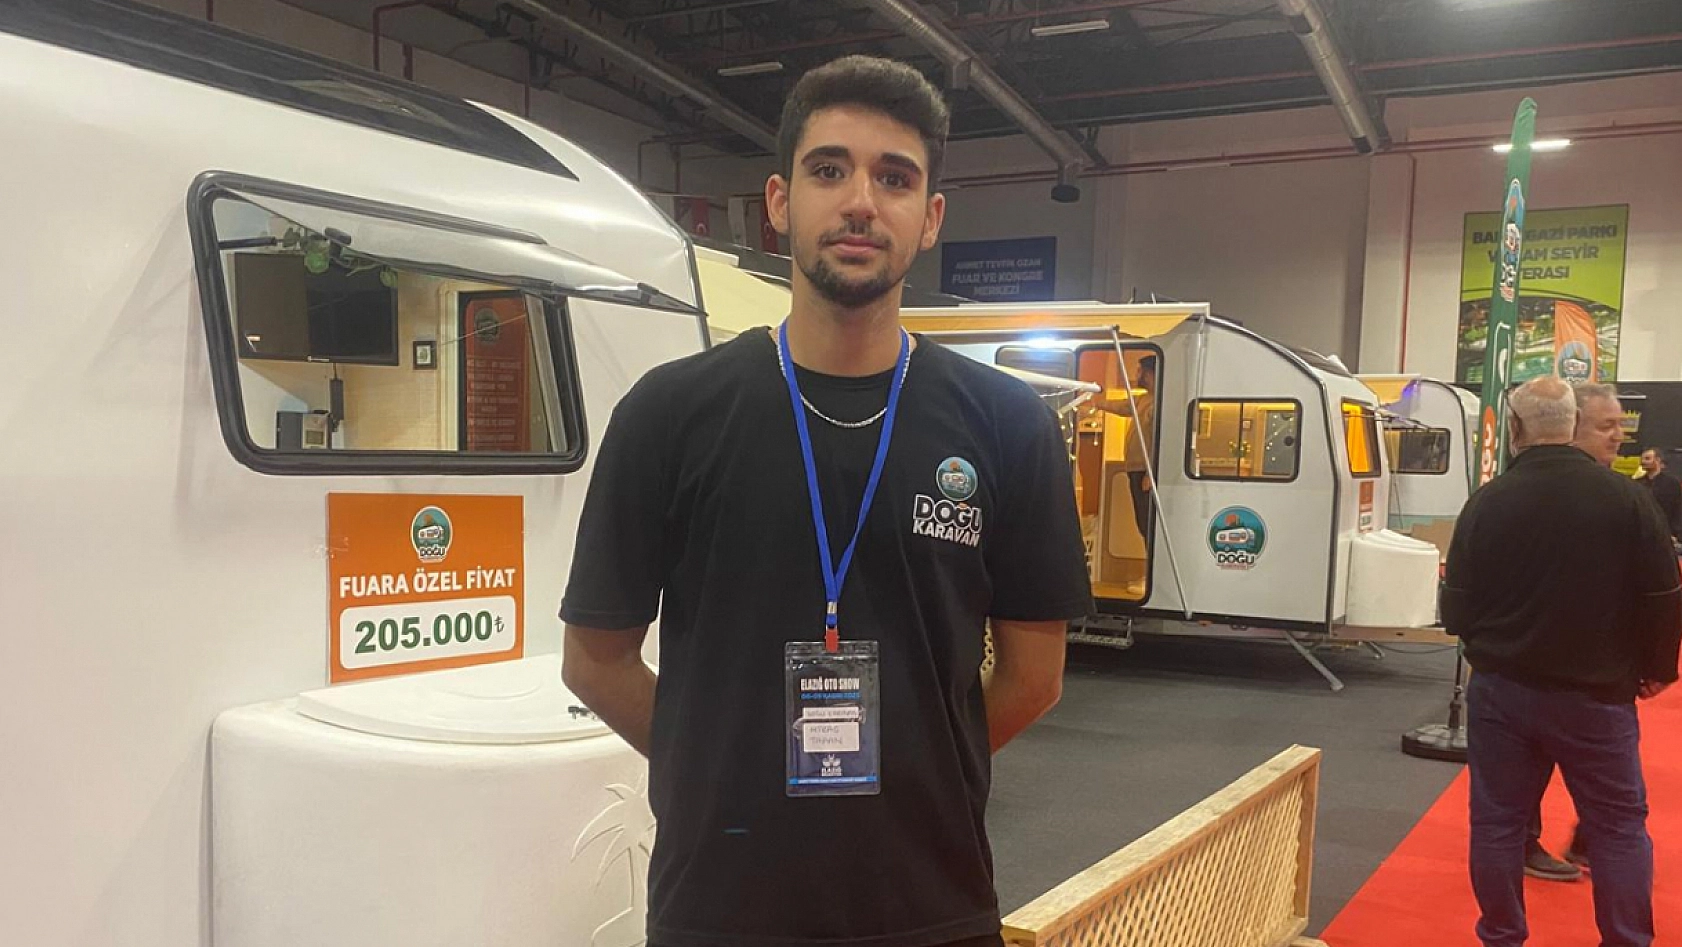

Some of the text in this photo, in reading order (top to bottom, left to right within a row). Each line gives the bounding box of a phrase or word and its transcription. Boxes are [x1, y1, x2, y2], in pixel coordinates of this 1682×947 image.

[1567, 225, 1617, 239] PARKI
[1551, 243, 1599, 259] SEYİR
[913, 494, 982, 533] DOĞU
[913, 519, 980, 547] KARAVAN
[1217, 551, 1255, 564] DOĞU
[340, 565, 516, 598] FUARA ÖZEL FİYAT
[824, 678, 838, 691] OTO
[839, 678, 860, 690] SHOW
